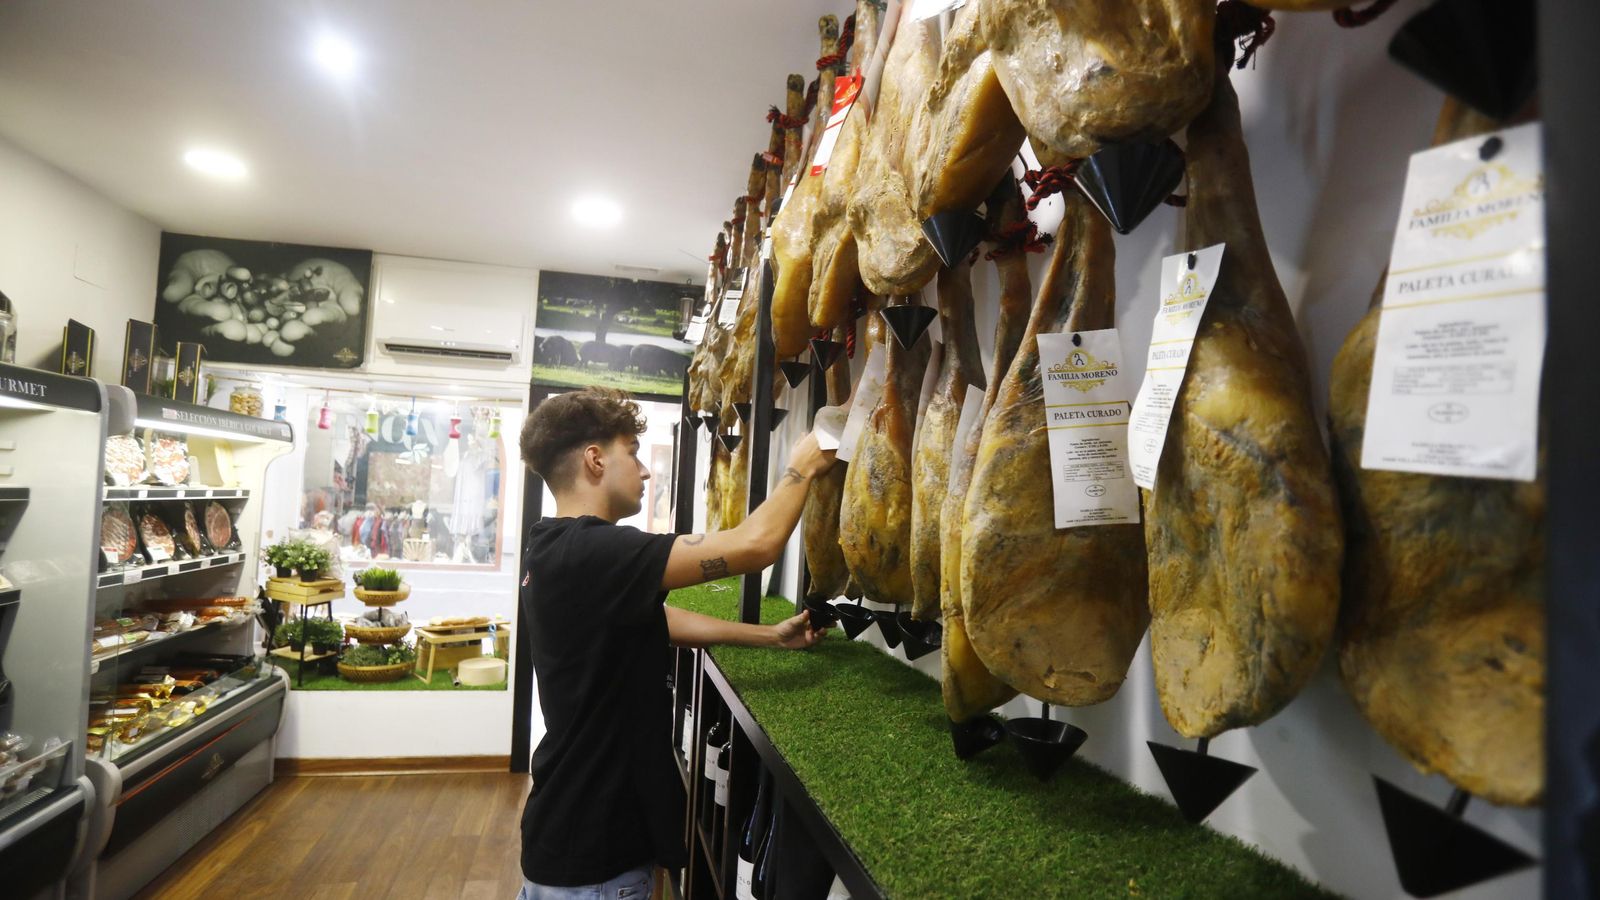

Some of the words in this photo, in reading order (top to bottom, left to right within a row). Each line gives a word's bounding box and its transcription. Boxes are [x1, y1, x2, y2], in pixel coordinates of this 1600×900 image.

[1409, 209, 1470, 230] FAMILIA
[1399, 275, 1455, 294] PALETA
[1048, 371, 1080, 381] FAMILIA
[1081, 369, 1118, 379] MORENO
[176, 410, 218, 426] SELECCIÓN
[1054, 411, 1086, 421] PALETA
[1087, 408, 1122, 419] CURADO
